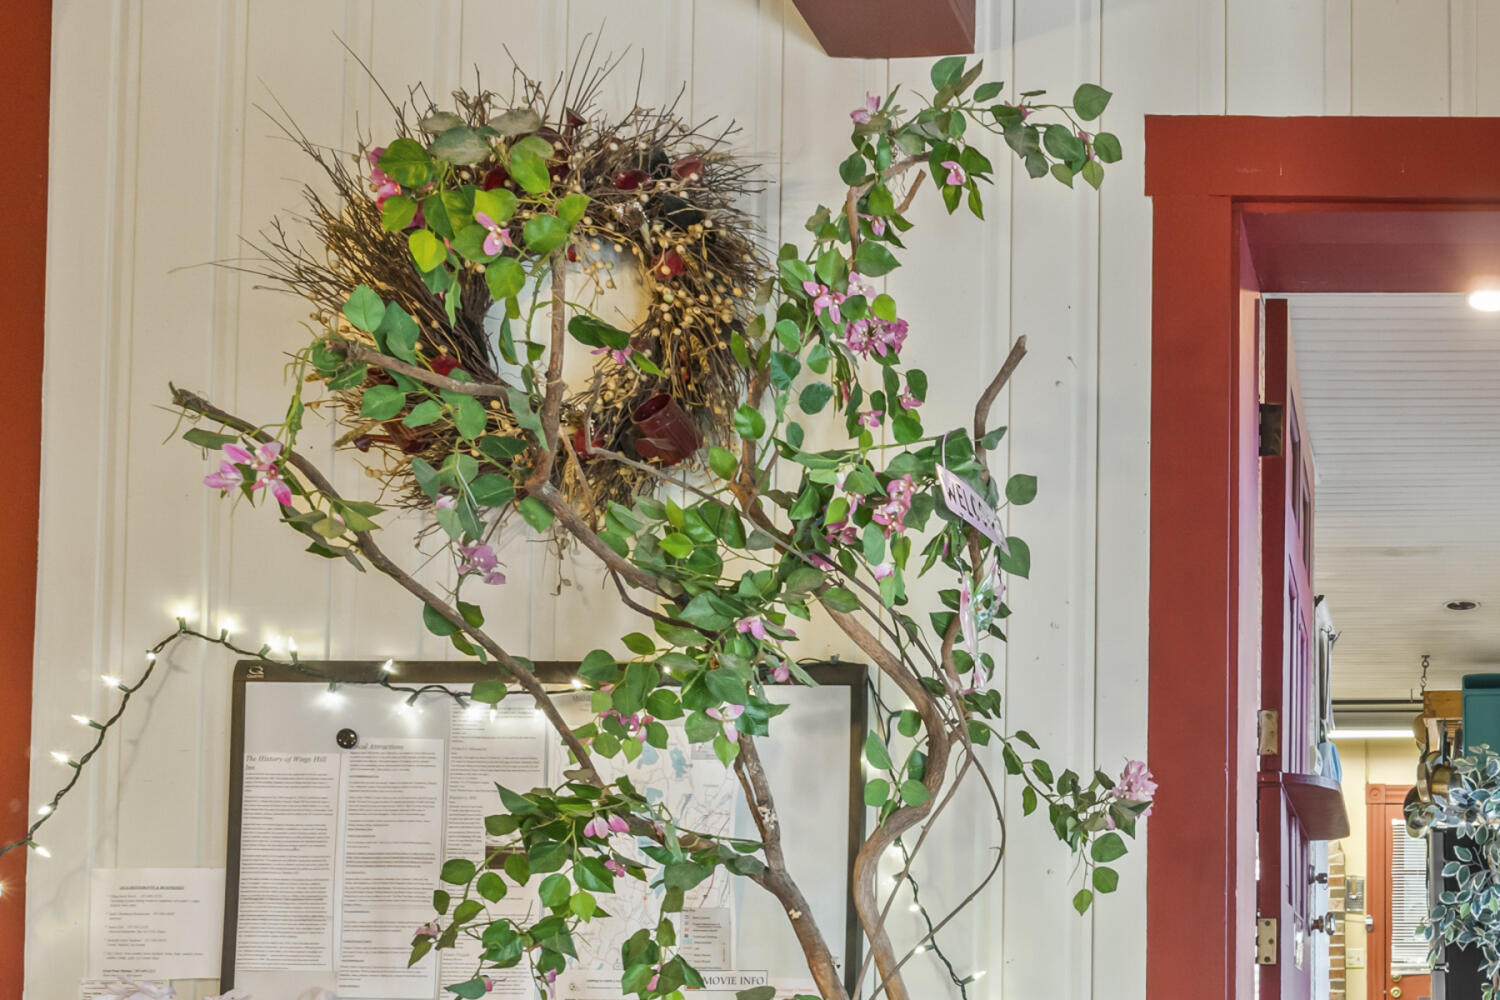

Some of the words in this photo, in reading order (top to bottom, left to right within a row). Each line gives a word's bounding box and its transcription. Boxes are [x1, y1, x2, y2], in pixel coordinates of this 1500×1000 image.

[258, 755, 283, 764] History
[703, 975, 738, 986] MOVIE
[740, 975, 766, 986] INFO
